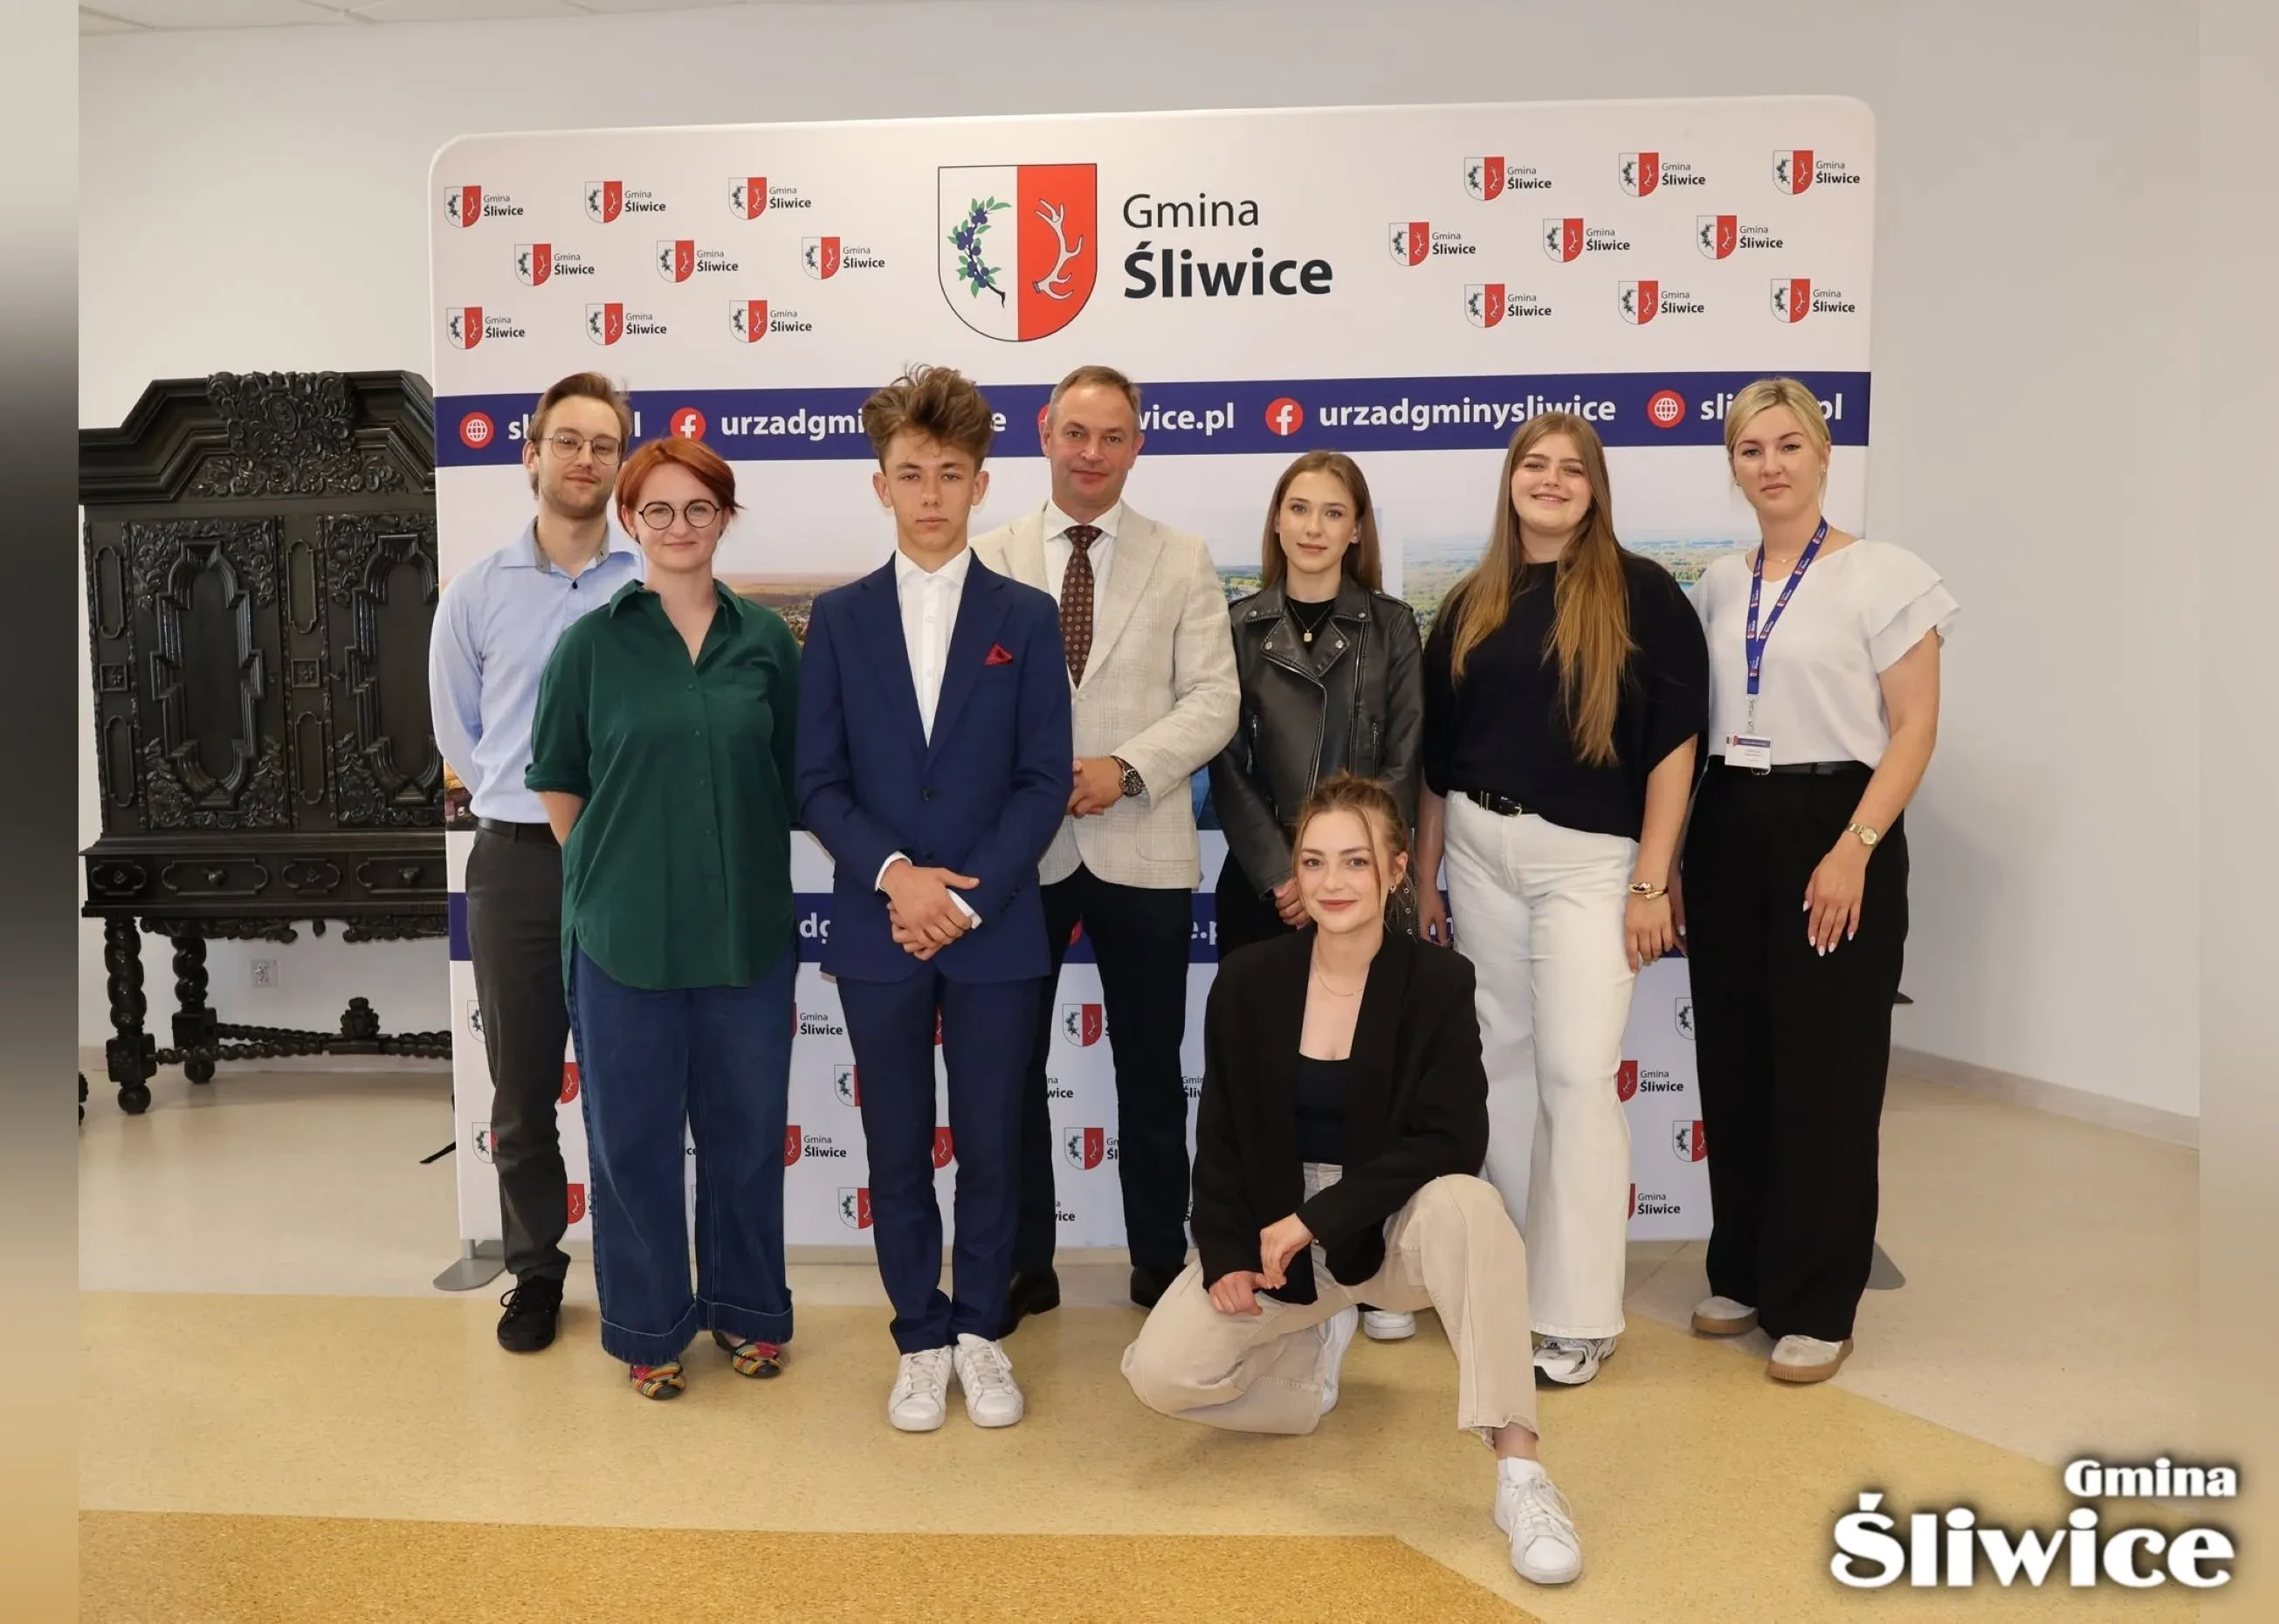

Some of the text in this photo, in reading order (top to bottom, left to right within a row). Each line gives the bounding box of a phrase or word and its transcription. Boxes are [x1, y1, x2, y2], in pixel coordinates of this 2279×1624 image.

[1506, 166, 1537, 175] Gmina
[1661, 162, 1691, 172] Gmina
[1815, 160, 1846, 169] Gmina
[1507, 176, 1553, 189] Śliwice
[1662, 172, 1706, 186] Śliwice
[1815, 170, 1861, 184] Śliwice
[623, 189, 652, 199] Gmina
[768, 186, 797, 196] Gmina
[483, 194, 511, 203] Gmina
[769, 196, 812, 210] Śliwice
[483, 204, 524, 217] Śliwice
[624, 199, 666, 212] Śliwice
[1123, 192, 1259, 229] Gmina
[1586, 227, 1615, 237] Gmina
[1739, 224, 1769, 234] Gmina
[1431, 231, 1462, 241] Gmina
[1739, 235, 1784, 249] Śliwice
[842, 245, 871, 255] Gmina
[1432, 242, 1477, 255] Śliwice
[1586, 237, 1630, 251] Śliwice
[554, 252, 582, 262] Gmina
[696, 249, 725, 258] Gmina
[554, 262, 596, 276] Śliwice
[697, 259, 739, 272] Śliwice
[843, 256, 885, 269] Śliwice
[1124, 240, 1333, 299] Śliwice
[1507, 293, 1537, 303] Gmina
[1661, 290, 1690, 299] Gmina
[1812, 288, 1842, 299] Gmina
[1507, 303, 1553, 317] Śliwice
[1661, 300, 1704, 314] Śliwice
[1812, 299, 1856, 313] Śliwice
[484, 315, 512, 325] Gmina
[625, 312, 653, 321] Gmina
[769, 309, 798, 319] Gmina
[485, 326, 526, 339] Śliwice
[626, 321, 667, 335] Śliwice
[770, 320, 813, 333] Śliwice
[799, 1012, 829, 1022] Gmina
[800, 1022, 843, 1036] Śliwice
[1640, 1070, 1670, 1079] Gmina
[1640, 1079, 1684, 1093] Śliwice
[802, 1134, 832, 1144] Gmina
[804, 1144, 847, 1158] Śliwice
[1637, 1193, 1667, 1201] Gmina
[1637, 1201, 1681, 1215] Śliwice
